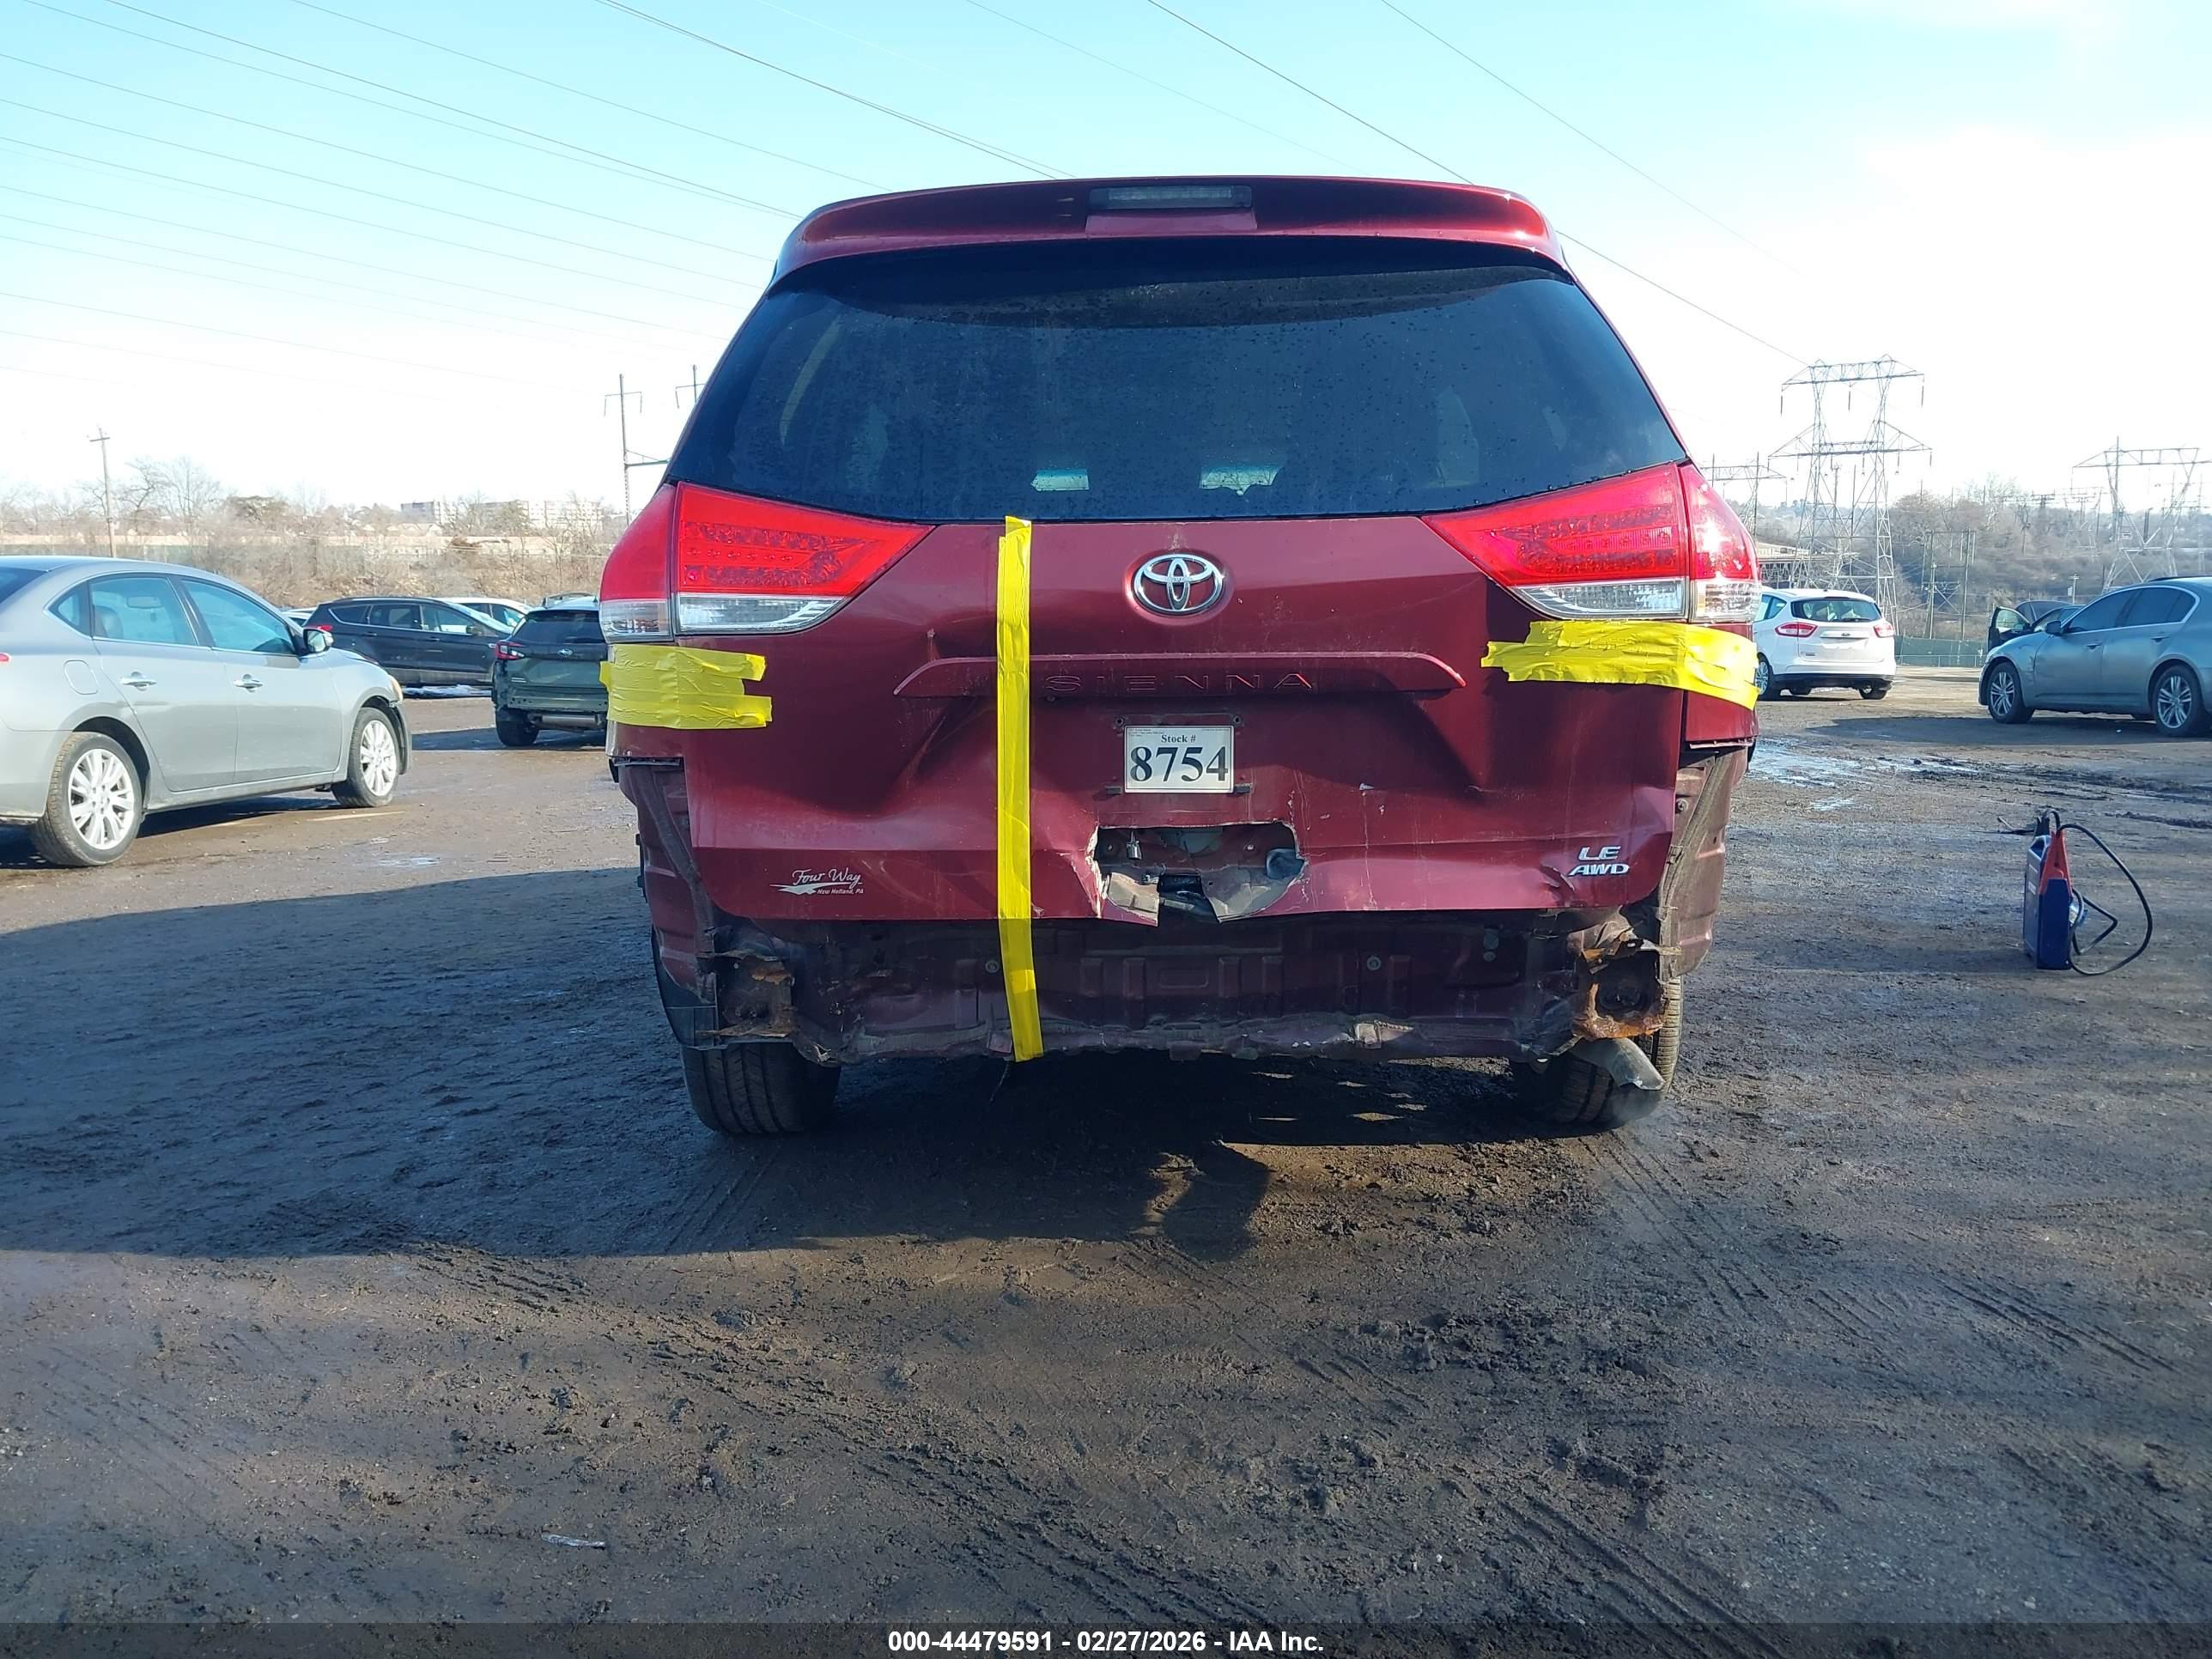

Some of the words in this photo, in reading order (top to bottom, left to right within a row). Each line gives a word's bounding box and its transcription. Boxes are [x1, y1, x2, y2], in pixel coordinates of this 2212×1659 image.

[1043, 673, 1320, 693] SIENNA
[1161, 734, 1188, 744] Stock
[1190, 734, 1197, 744] #
[1130, 745, 1229, 782] 8754
[1577, 845, 1621, 861] LE
[792, 868, 826, 886] Four
[828, 866, 861, 890] Way
[1568, 863, 1631, 877] AWD
